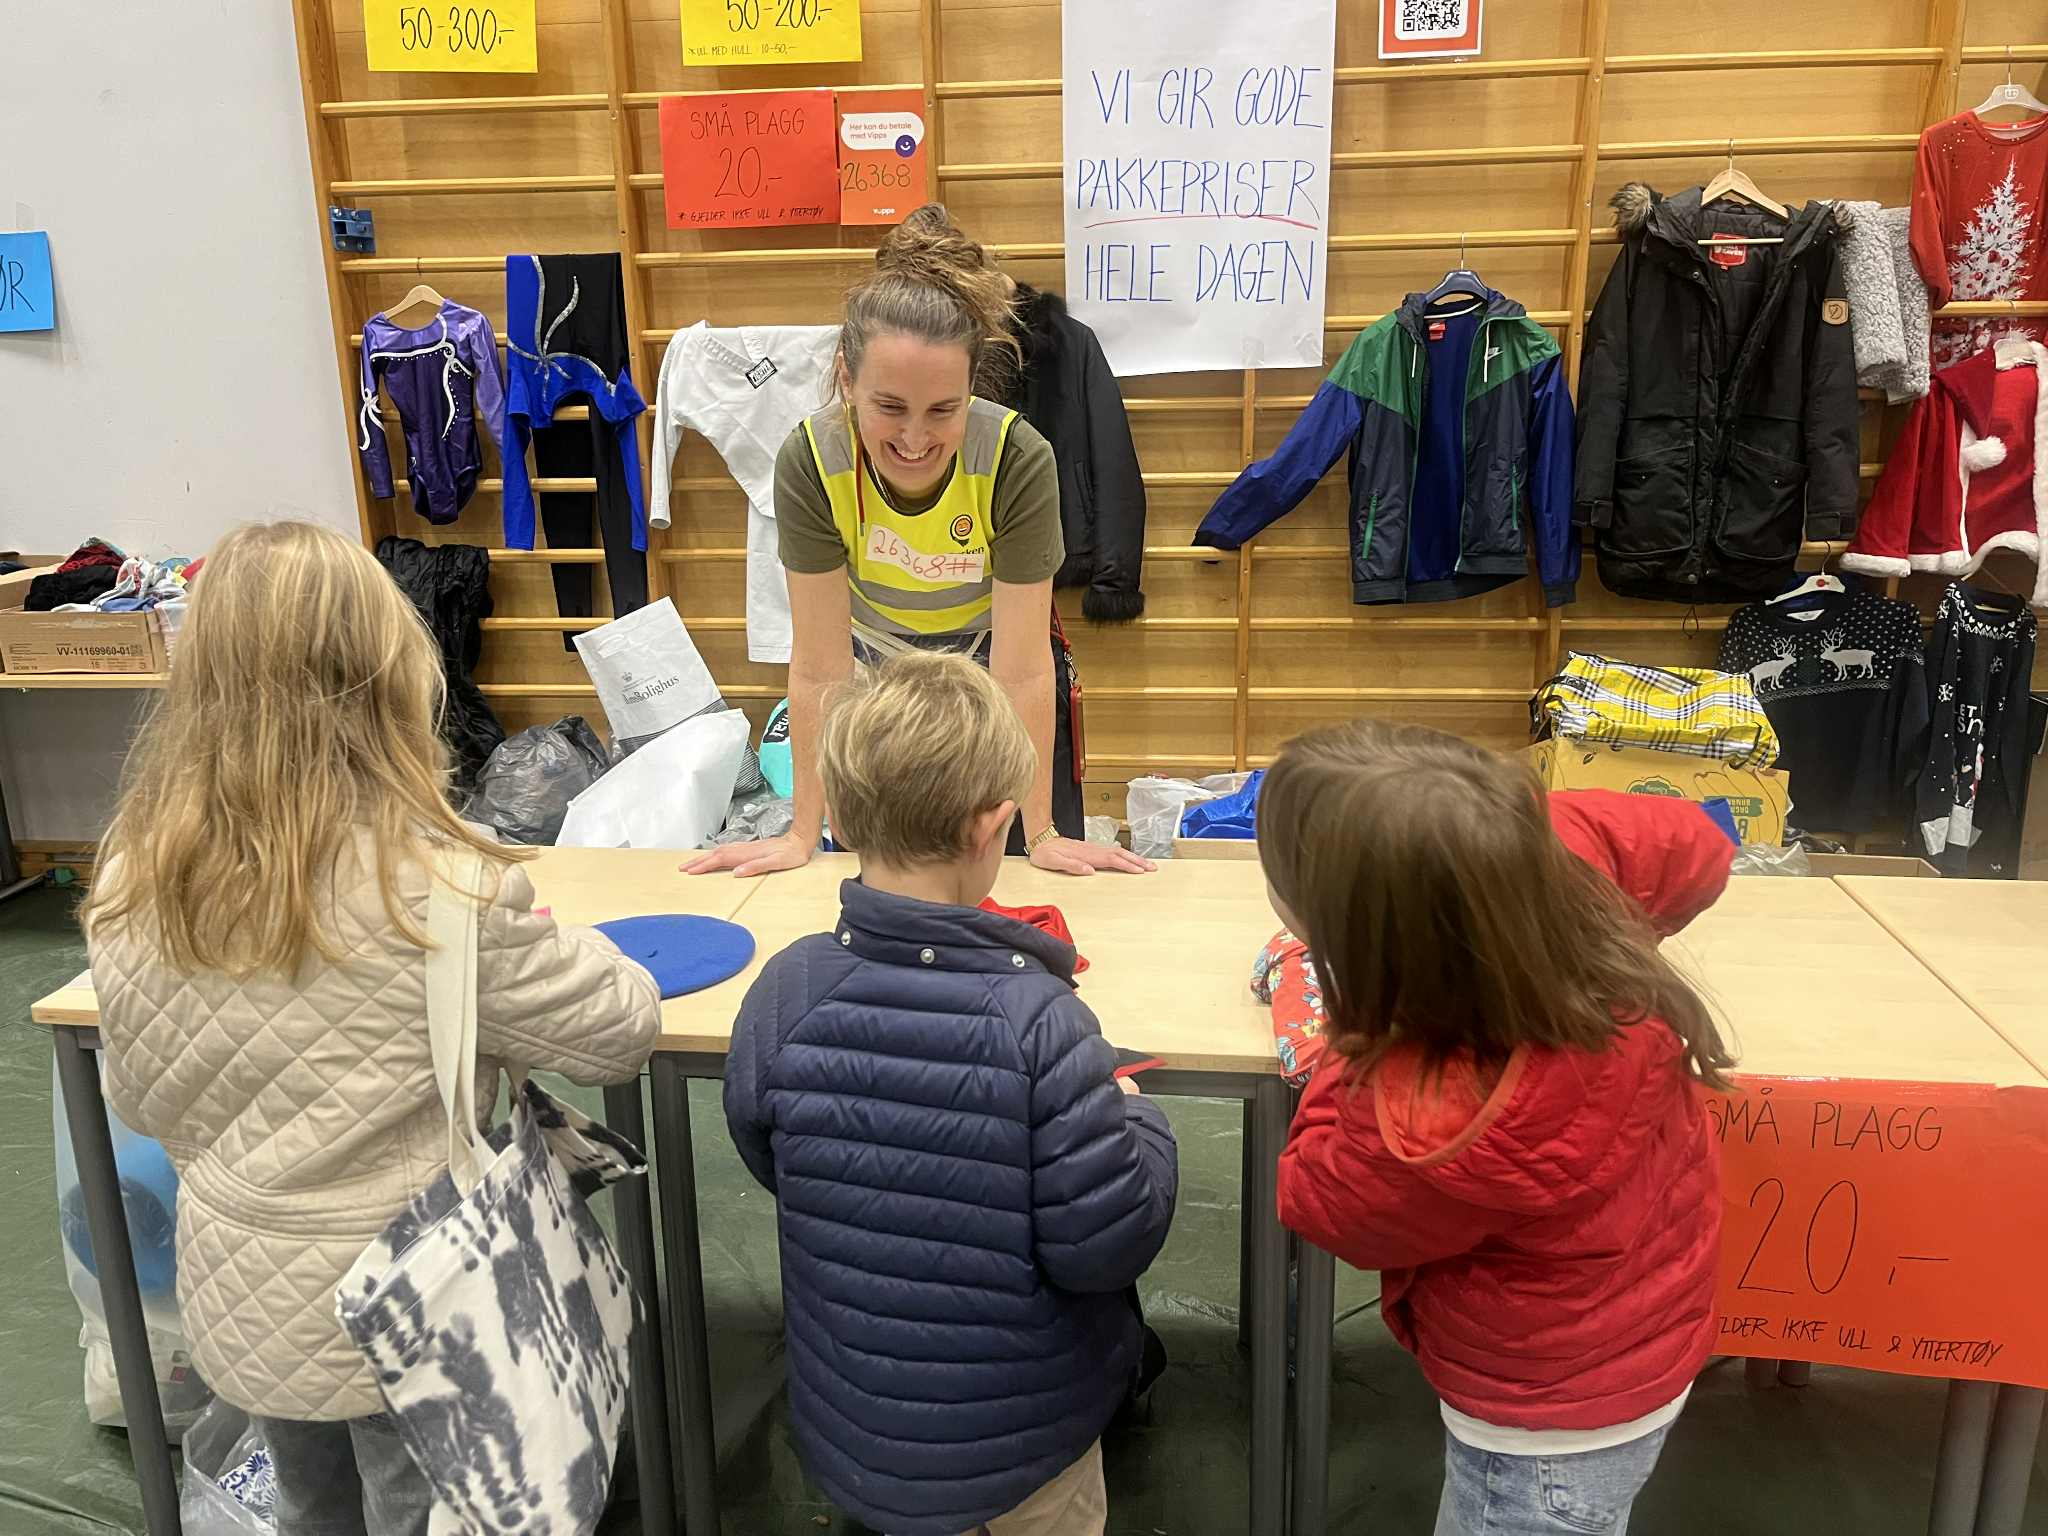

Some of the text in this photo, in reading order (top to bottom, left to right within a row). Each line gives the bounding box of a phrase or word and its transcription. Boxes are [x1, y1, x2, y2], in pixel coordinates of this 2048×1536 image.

[690, 102, 806, 140] SMÅ PLAGG
[1091, 64, 1325, 129] VI GIR GODE
[843, 161, 912, 192] 26368
[1077, 156, 1321, 221] PAKKEPRISER
[1085, 240, 1315, 304] HELE DAGEN
[1811, 1101, 1943, 1153] PLAGG
[1782, 1316, 1829, 1343] IKKE
[1838, 1326, 1873, 1351] ULL
[1911, 1336, 2004, 1368] YTTERTØY
